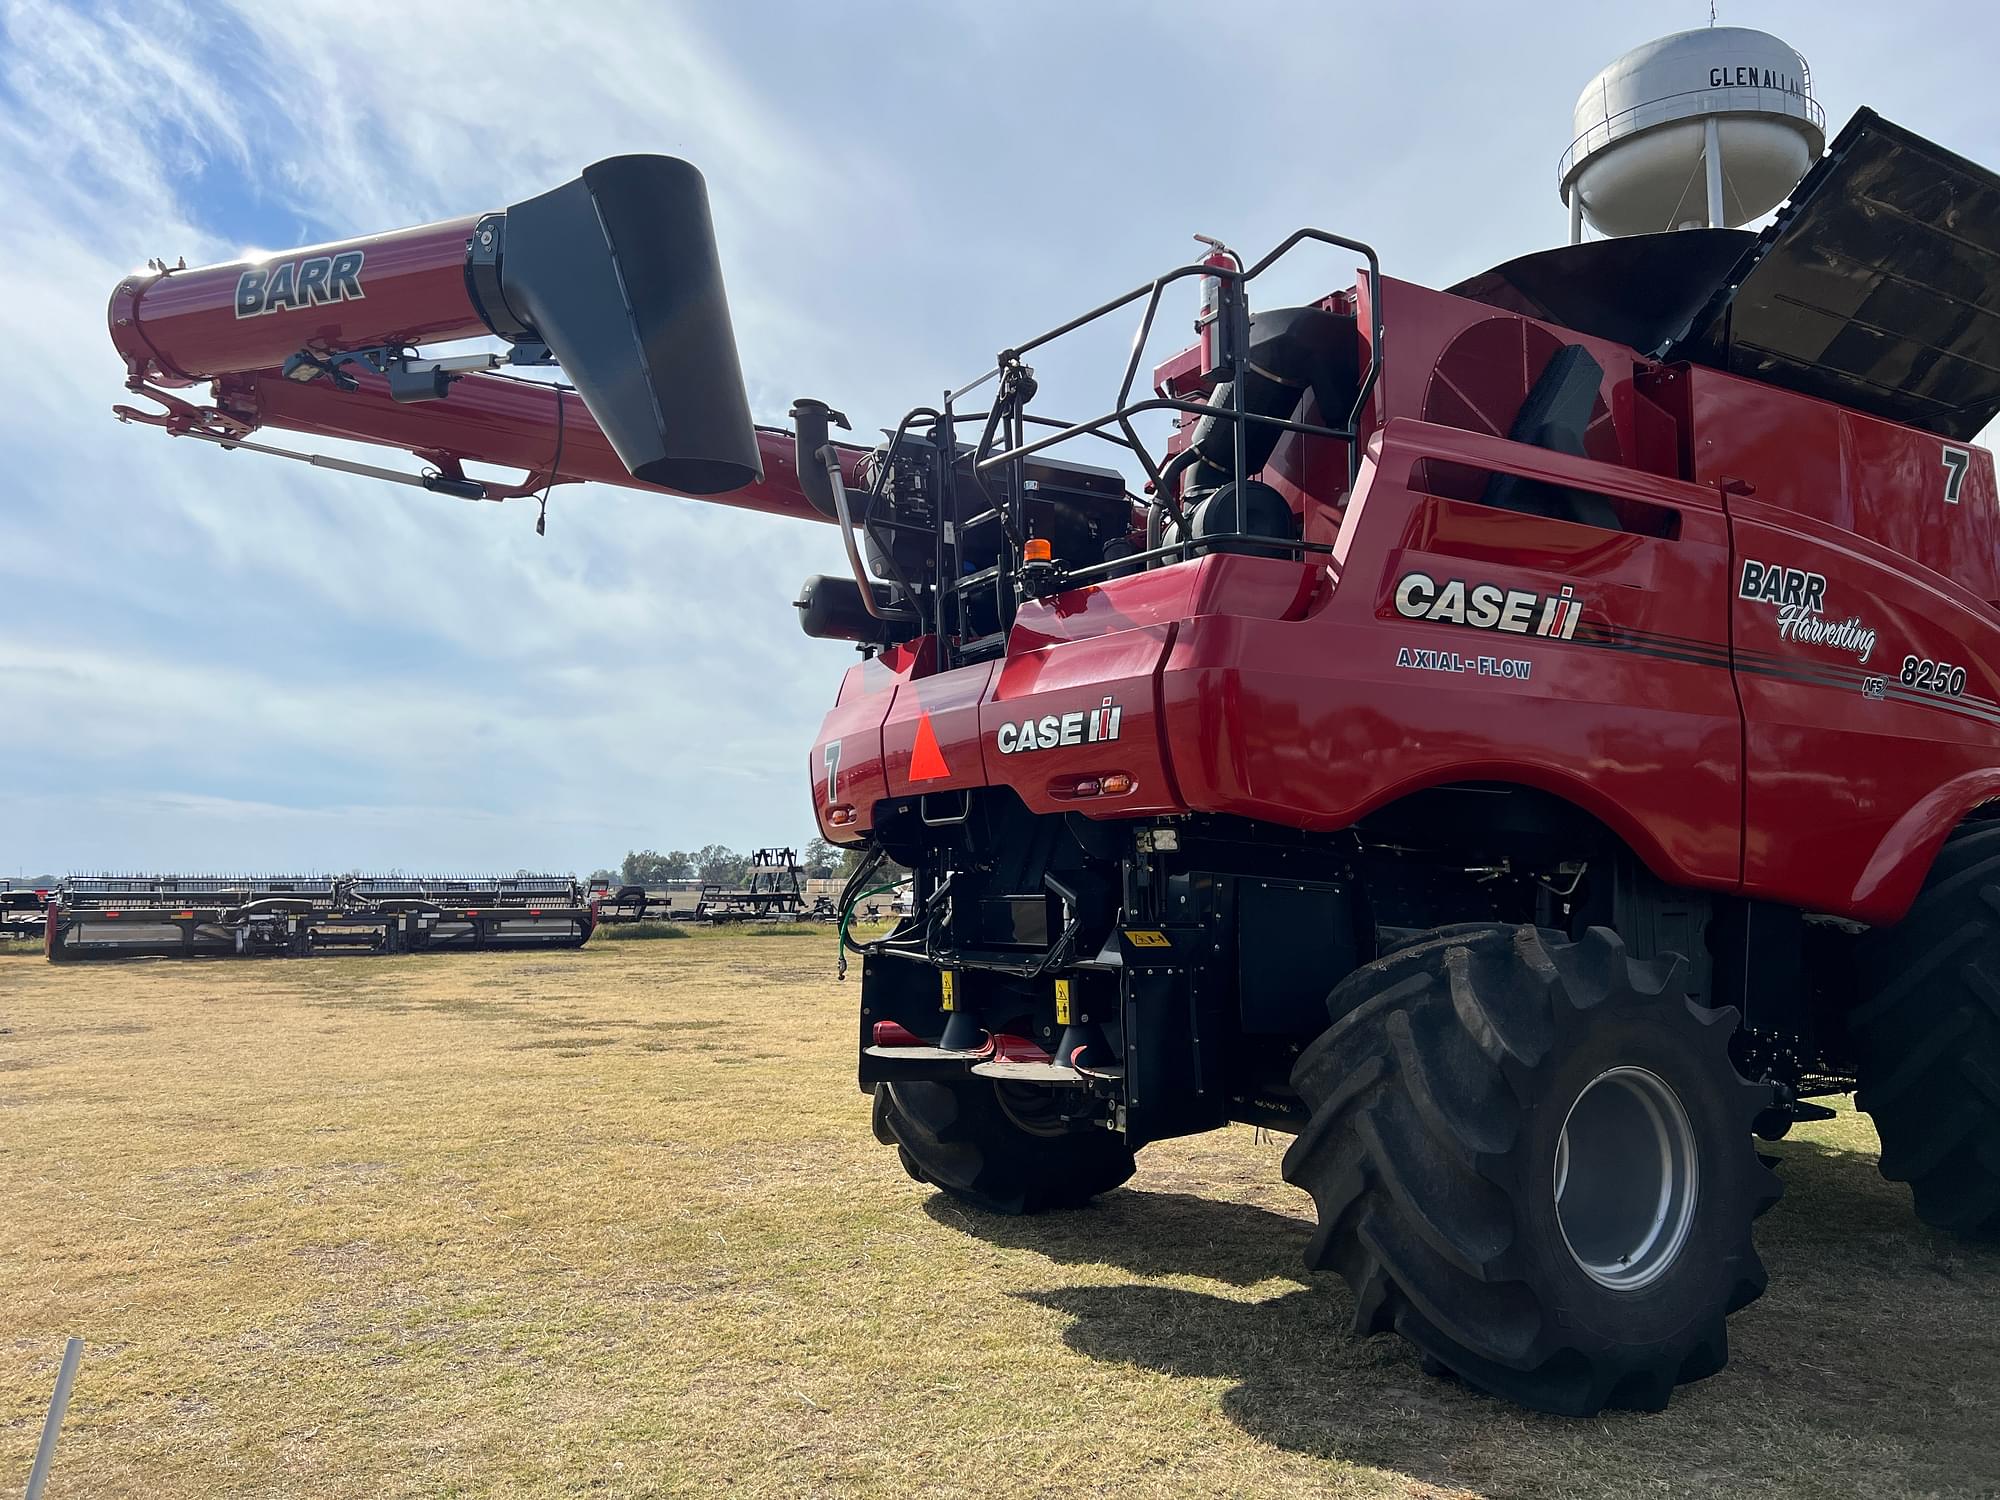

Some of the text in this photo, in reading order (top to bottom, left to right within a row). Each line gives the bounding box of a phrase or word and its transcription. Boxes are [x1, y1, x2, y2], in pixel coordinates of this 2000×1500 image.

[1709, 66, 1759, 88] GLEN
[235, 250, 366, 320] BARR
[1942, 445, 1970, 504] 7
[1394, 572, 1538, 634] CASE
[1739, 559, 1827, 613] BARR
[1776, 604, 1877, 665] Harvesting
[1396, 647, 1531, 680] AXIAL-FLOW
[1900, 655, 1967, 697] 8250
[996, 711, 1085, 755] CASE
[824, 739, 842, 805] 7
